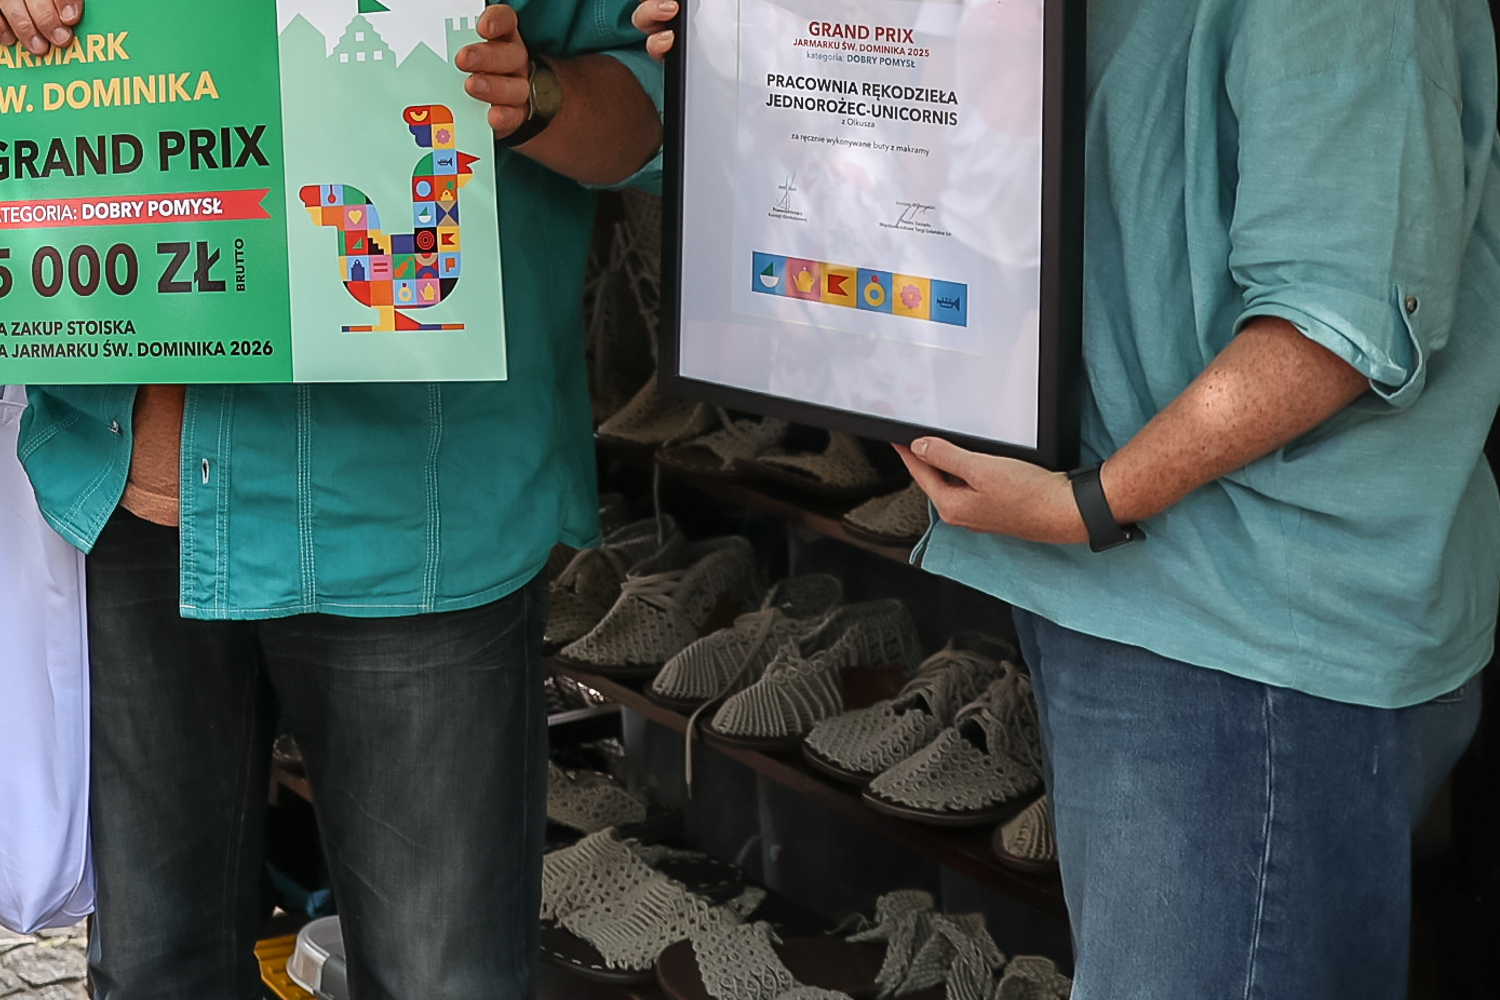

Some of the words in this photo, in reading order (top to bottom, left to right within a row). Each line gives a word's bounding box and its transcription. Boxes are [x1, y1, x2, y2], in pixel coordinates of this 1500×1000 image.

[808, 21, 870, 40] GRAND
[875, 26, 915, 44] PRIX
[793, 38, 840, 51] JARMARKU
[841, 40, 858, 52] ŚW.
[859, 44, 906, 56] DOMINIKA
[907, 48, 930, 57] 2025
[806, 51, 845, 64] kategoria:
[846, 54, 877, 66] DOBRY
[879, 57, 916, 69] POMYSŁ
[43, 70, 220, 112] DOMINIKA
[766, 73, 859, 96] PRACOWNIA
[862, 82, 959, 105] RĘKODZIEŁA
[765, 93, 958, 126] JEDNOROŻEC-UNICORNIS
[846, 118, 875, 129] Olkusza
[158, 125, 270, 172] PRIX
[800, 134, 826, 143] ręcznie
[826, 137, 872, 148] wykonywane
[872, 141, 890, 152] buty
[896, 145, 930, 157] makramy
[81, 201, 142, 220] DOBRY
[147, 197, 223, 217] POMYSŁ
[31, 242, 139, 298] 000
[156, 240, 227, 294] ZŁ
[234, 238, 245, 293] BRUTTO
[10, 320, 64, 337] ZAKUP
[66, 319, 136, 336] STOISKA
[11, 342, 99, 359] JARMARKU
[102, 339, 133, 358] ŚW.
[137, 340, 226, 358] DOMINIKA
[230, 340, 274, 357] 2026
